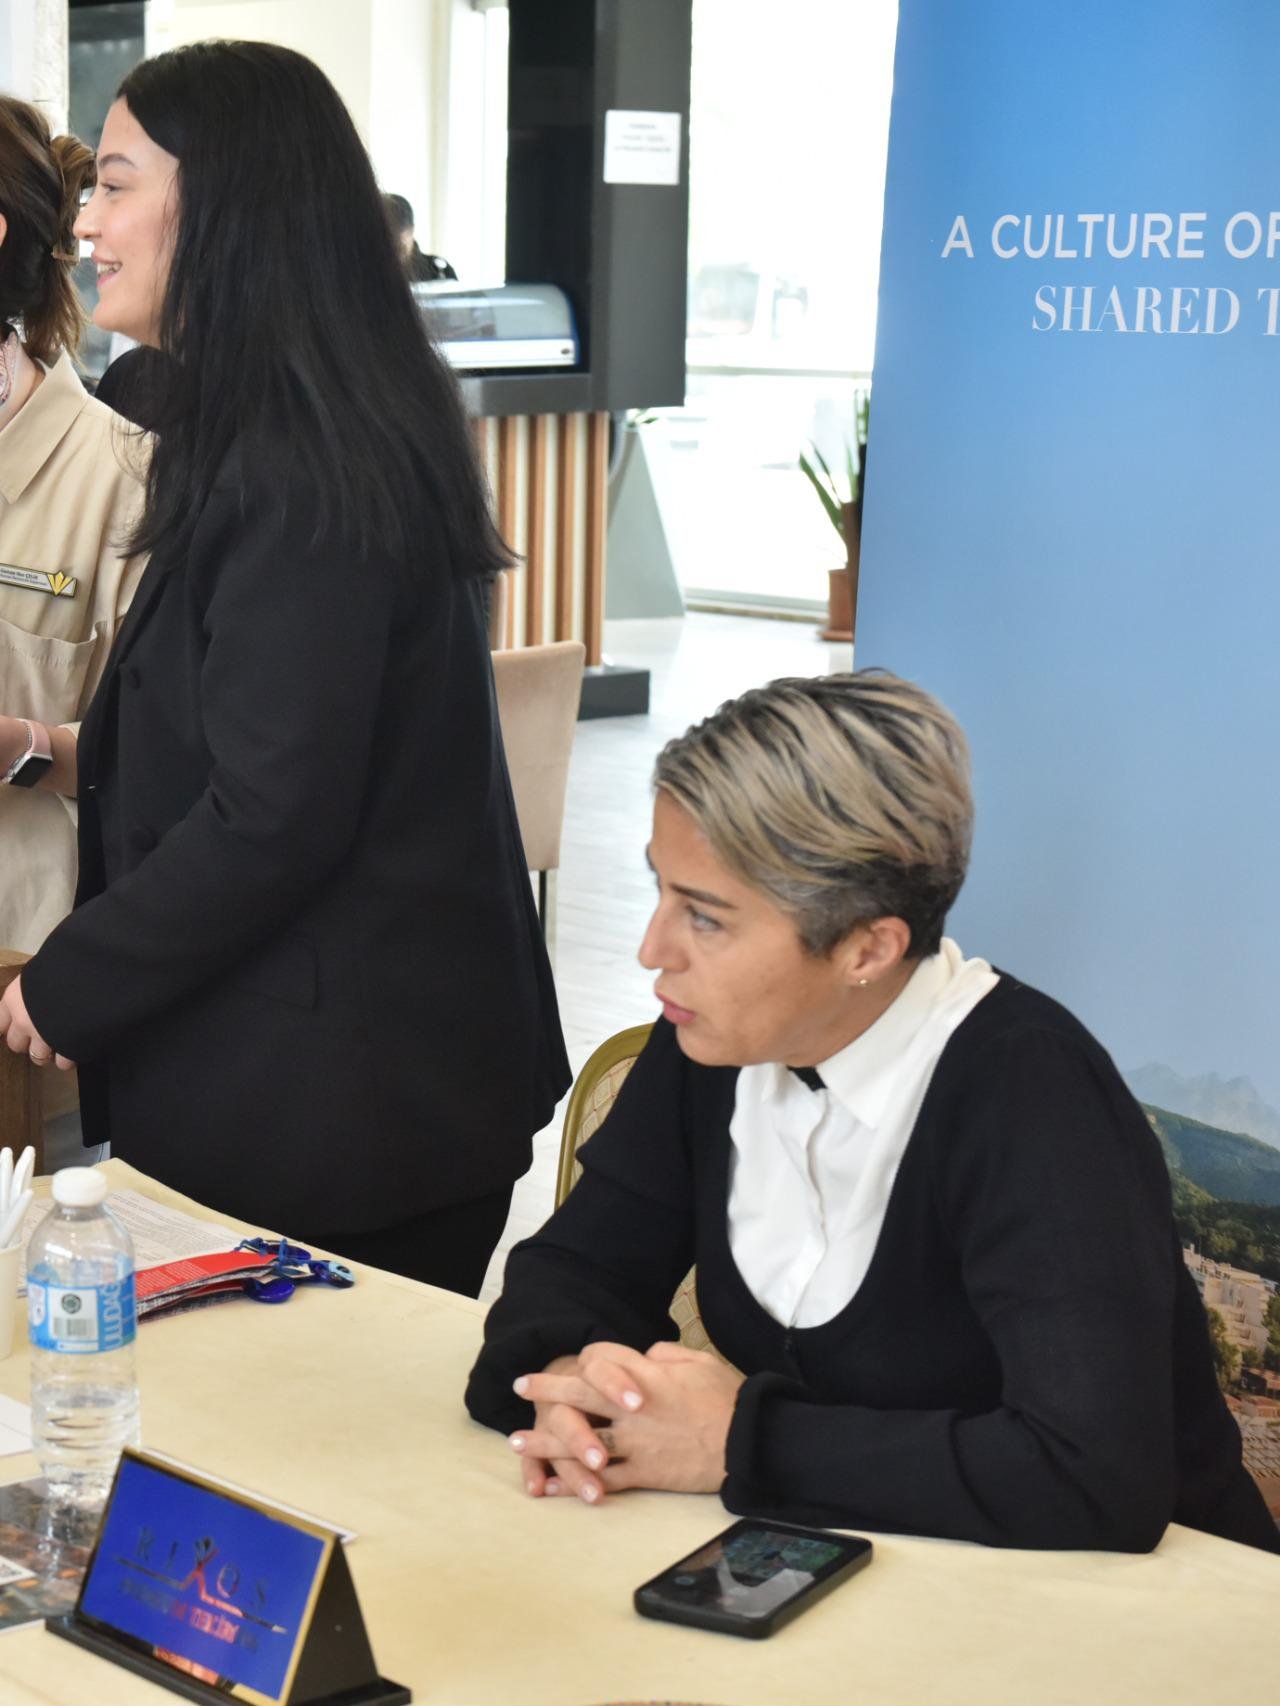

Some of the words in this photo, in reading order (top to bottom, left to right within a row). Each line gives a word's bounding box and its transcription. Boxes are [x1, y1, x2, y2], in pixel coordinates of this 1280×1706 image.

[940, 215, 975, 258] A
[991, 212, 1208, 259] CULTURE
[1031, 283, 1241, 336] SHARED
